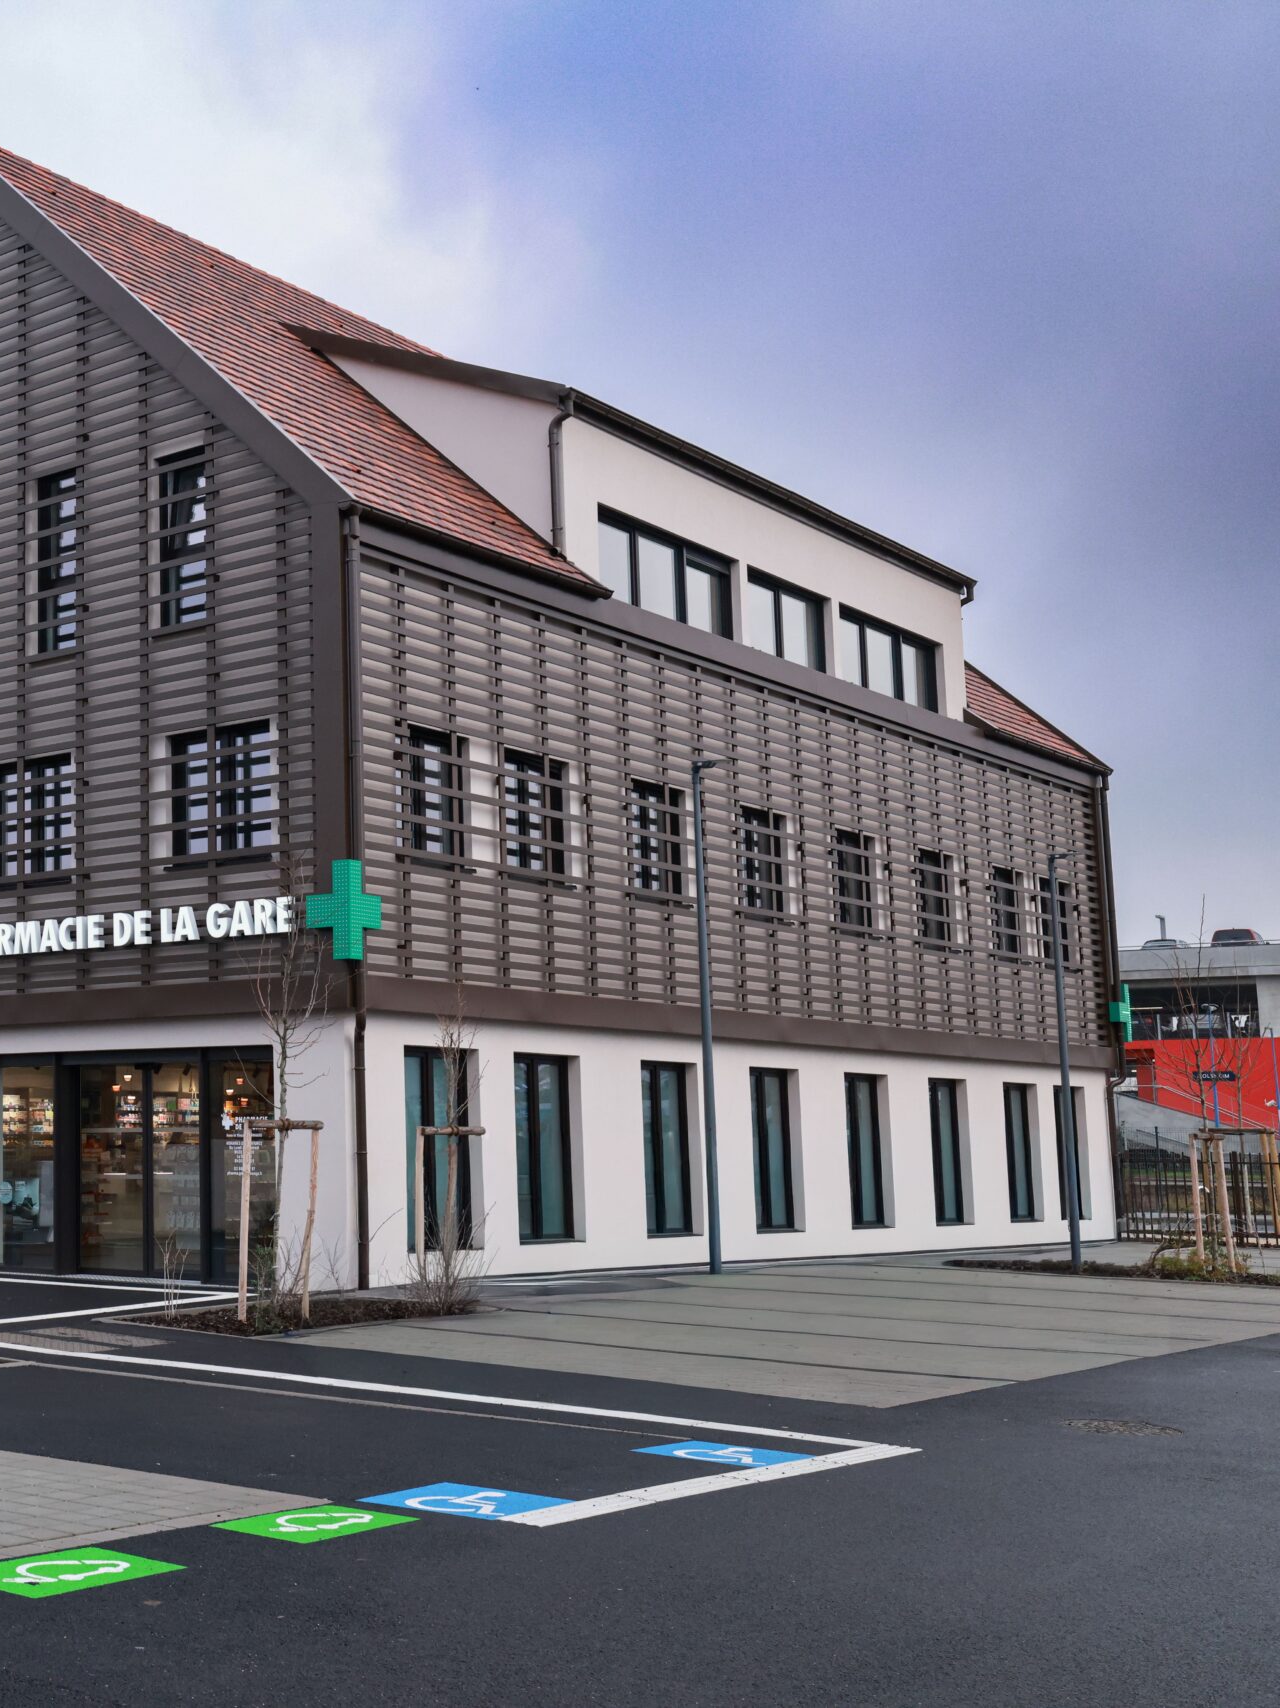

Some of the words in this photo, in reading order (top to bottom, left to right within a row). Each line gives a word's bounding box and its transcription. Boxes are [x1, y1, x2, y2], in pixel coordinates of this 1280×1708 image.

[112, 910, 152, 947] DE
[160, 906, 200, 943] LA
[206, 897, 295, 938] GARE
